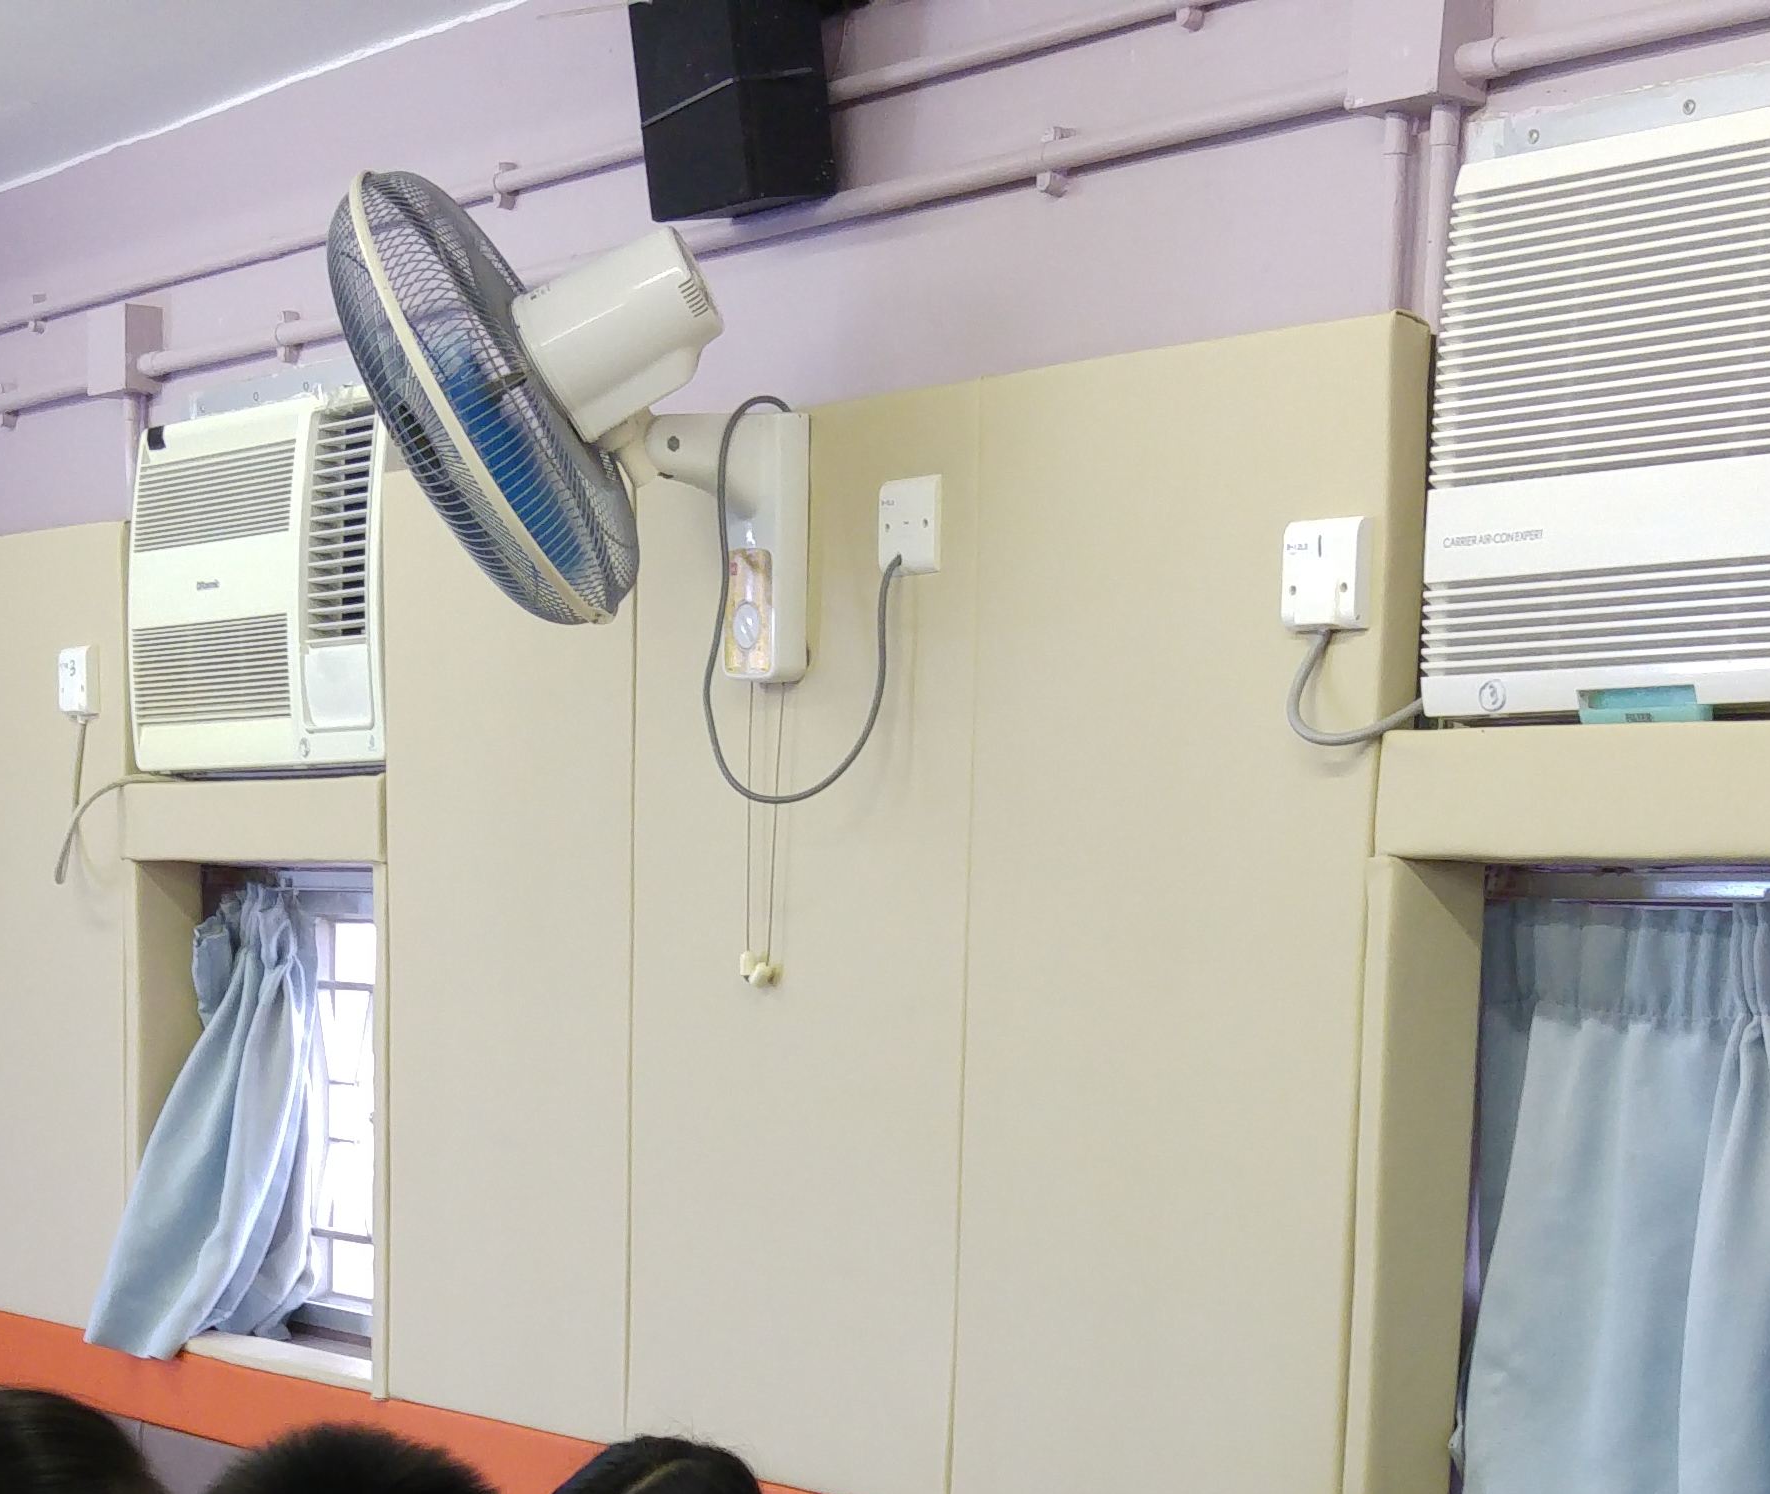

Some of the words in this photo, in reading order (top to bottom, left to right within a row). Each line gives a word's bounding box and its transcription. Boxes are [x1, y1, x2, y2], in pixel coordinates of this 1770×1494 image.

[1442, 535, 1478, 549] CARRIER
[1478, 532, 1514, 545] AIR-CON
[1514, 528, 1544, 542] EXPERT
[69, 659, 77, 677] 3
